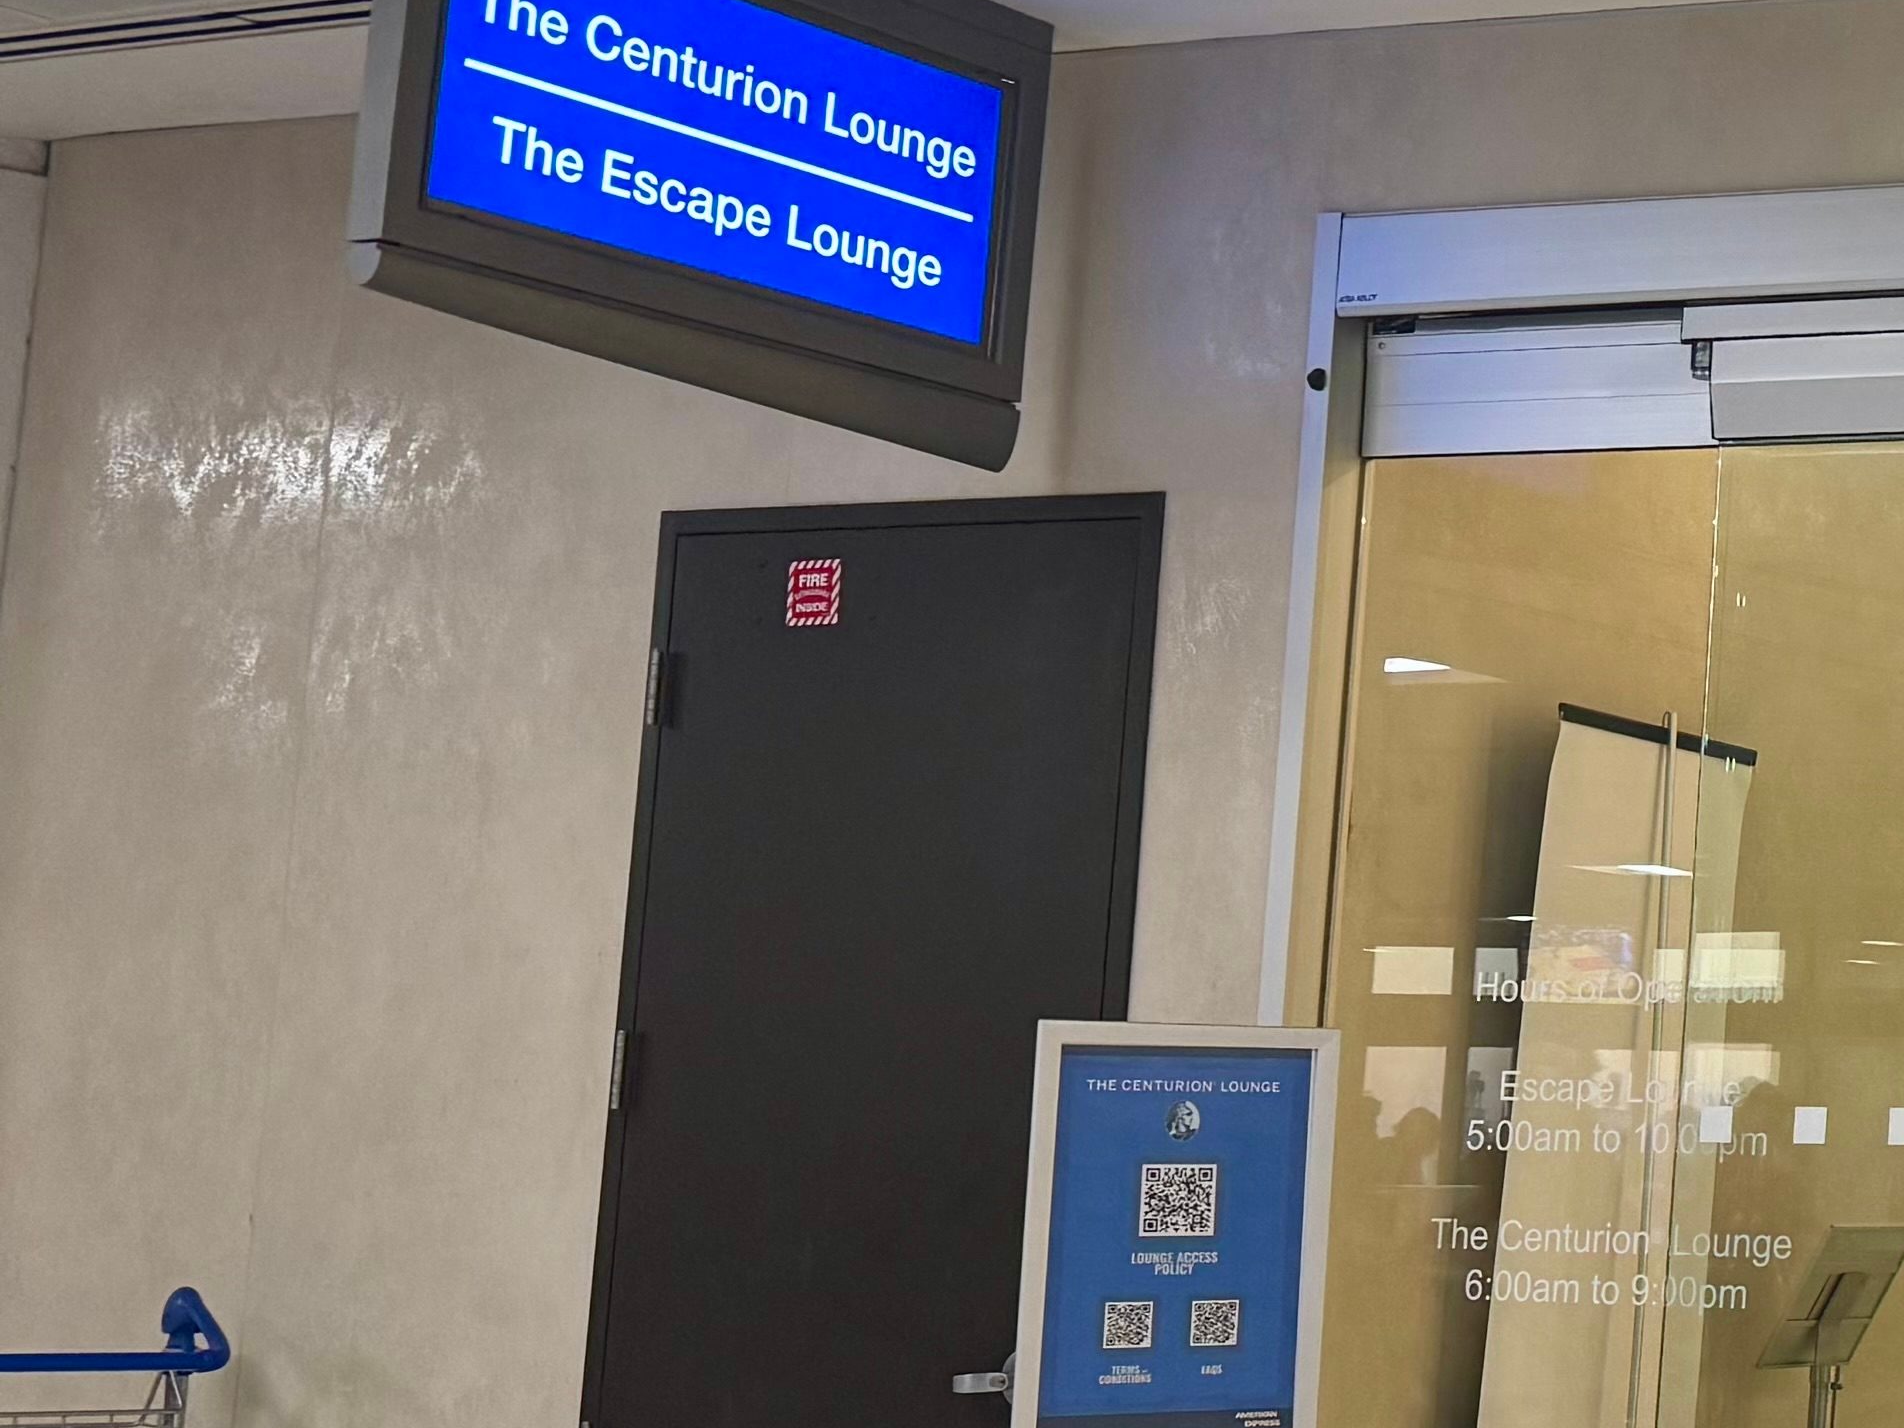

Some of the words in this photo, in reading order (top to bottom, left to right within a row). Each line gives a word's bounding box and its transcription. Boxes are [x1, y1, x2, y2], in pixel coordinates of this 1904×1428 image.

[585, 16, 809, 123] Centurion
[824, 92, 976, 179] Lounge
[491, 116, 584, 184] The
[600, 149, 771, 238] Escape
[786, 203, 942, 291] Lounge
[799, 573, 828, 587] FIRE
[1475, 972, 1567, 1003] Hours
[1087, 1079, 1116, 1091] THE
[1221, 1081, 1280, 1092] LOUNGE
[1500, 1070, 1614, 1110] Escape
[1466, 1120, 1580, 1152] 5:00am
[1593, 1123, 1620, 1153] to
[1131, 1252, 1174, 1264] LOUNGE
[1177, 1252, 1218, 1263] ACCESS
[1431, 1218, 1489, 1251] The
[1500, 1220, 1650, 1255] Centurion
[1672, 1224, 1792, 1267] Lounge
[1155, 1264, 1193, 1275] POLICY
[1465, 1269, 1579, 1304] 6:00am
[1592, 1274, 1620, 1306] to
[1631, 1274, 1747, 1317] 9:00pm
